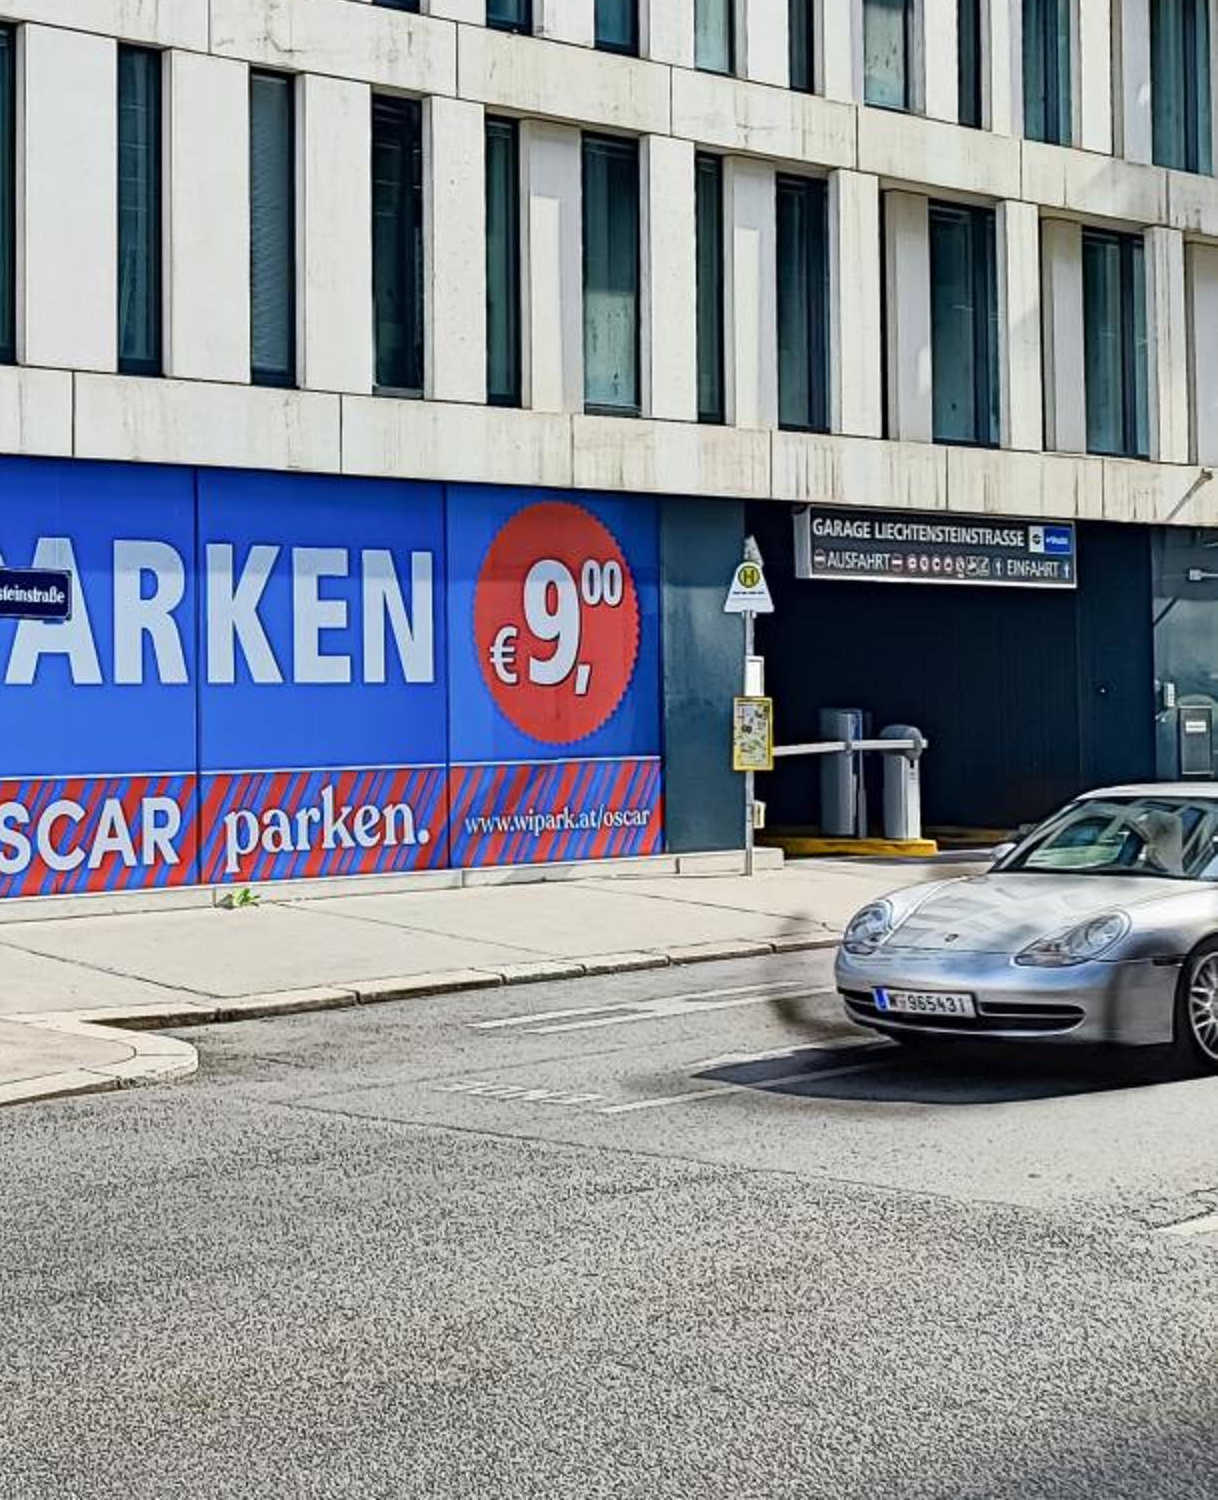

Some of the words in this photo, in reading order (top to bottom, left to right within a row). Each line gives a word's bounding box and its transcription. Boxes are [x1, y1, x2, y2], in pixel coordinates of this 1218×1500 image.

[812, 518, 872, 539] GARAGE
[874, 521, 1025, 547] LIECHTENSTEINSTRASSE
[827, 551, 891, 571] AUSFAHRT
[1007, 559, 1060, 578] EINFAHRT
[223, 785, 431, 874] parken.
[465, 803, 651, 837] www.wipark.at/oscar
